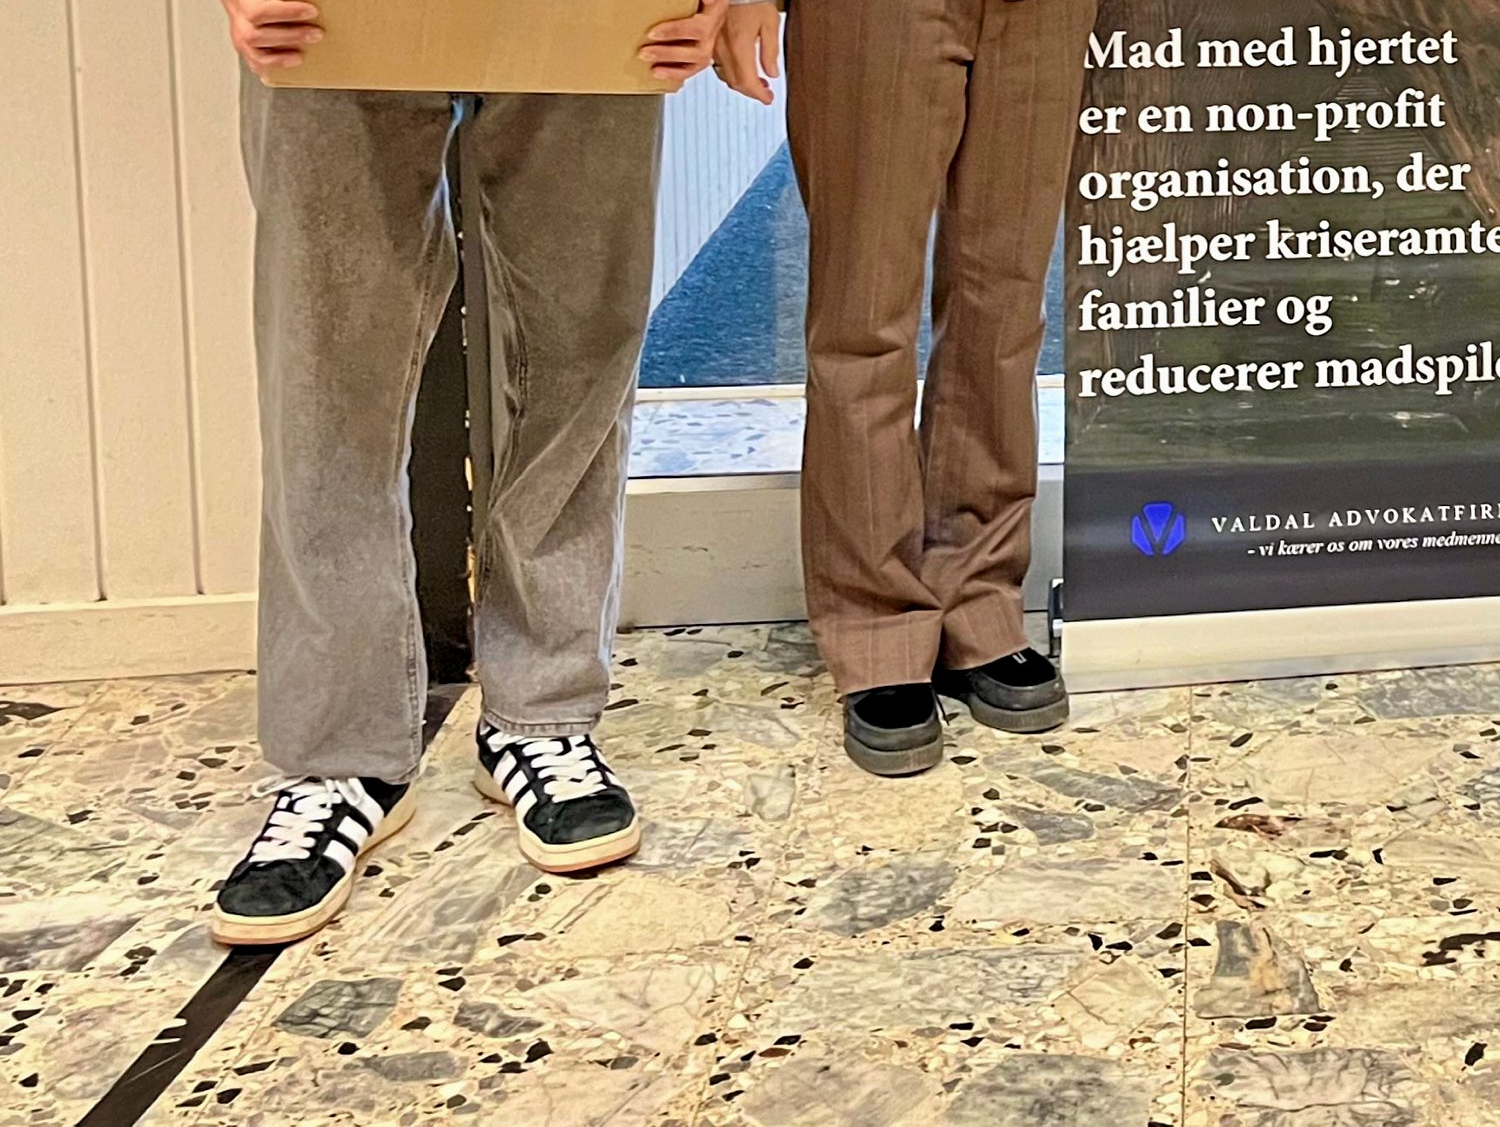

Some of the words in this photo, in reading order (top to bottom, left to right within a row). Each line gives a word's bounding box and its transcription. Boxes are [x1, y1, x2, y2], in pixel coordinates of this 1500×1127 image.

[1084, 28, 1184, 68] Mad
[1198, 27, 1296, 66] med
[1308, 27, 1457, 77] hjertet
[1080, 107, 1126, 134] er
[1139, 106, 1193, 132] en
[1206, 89, 1445, 141] non-profit
[1080, 157, 1383, 210] organisation,
[1397, 152, 1471, 191] der
[1079, 223, 1255, 277] hjælper
[1277, 296, 1332, 335] og
[1079, 354, 1303, 396] reducerer
[1212, 513, 1315, 532] VALDAL
[1259, 540, 1274, 557] vi
[1326, 538, 1345, 554] os
[1348, 536, 1373, 553] om
[1377, 537, 1419, 550] vores
